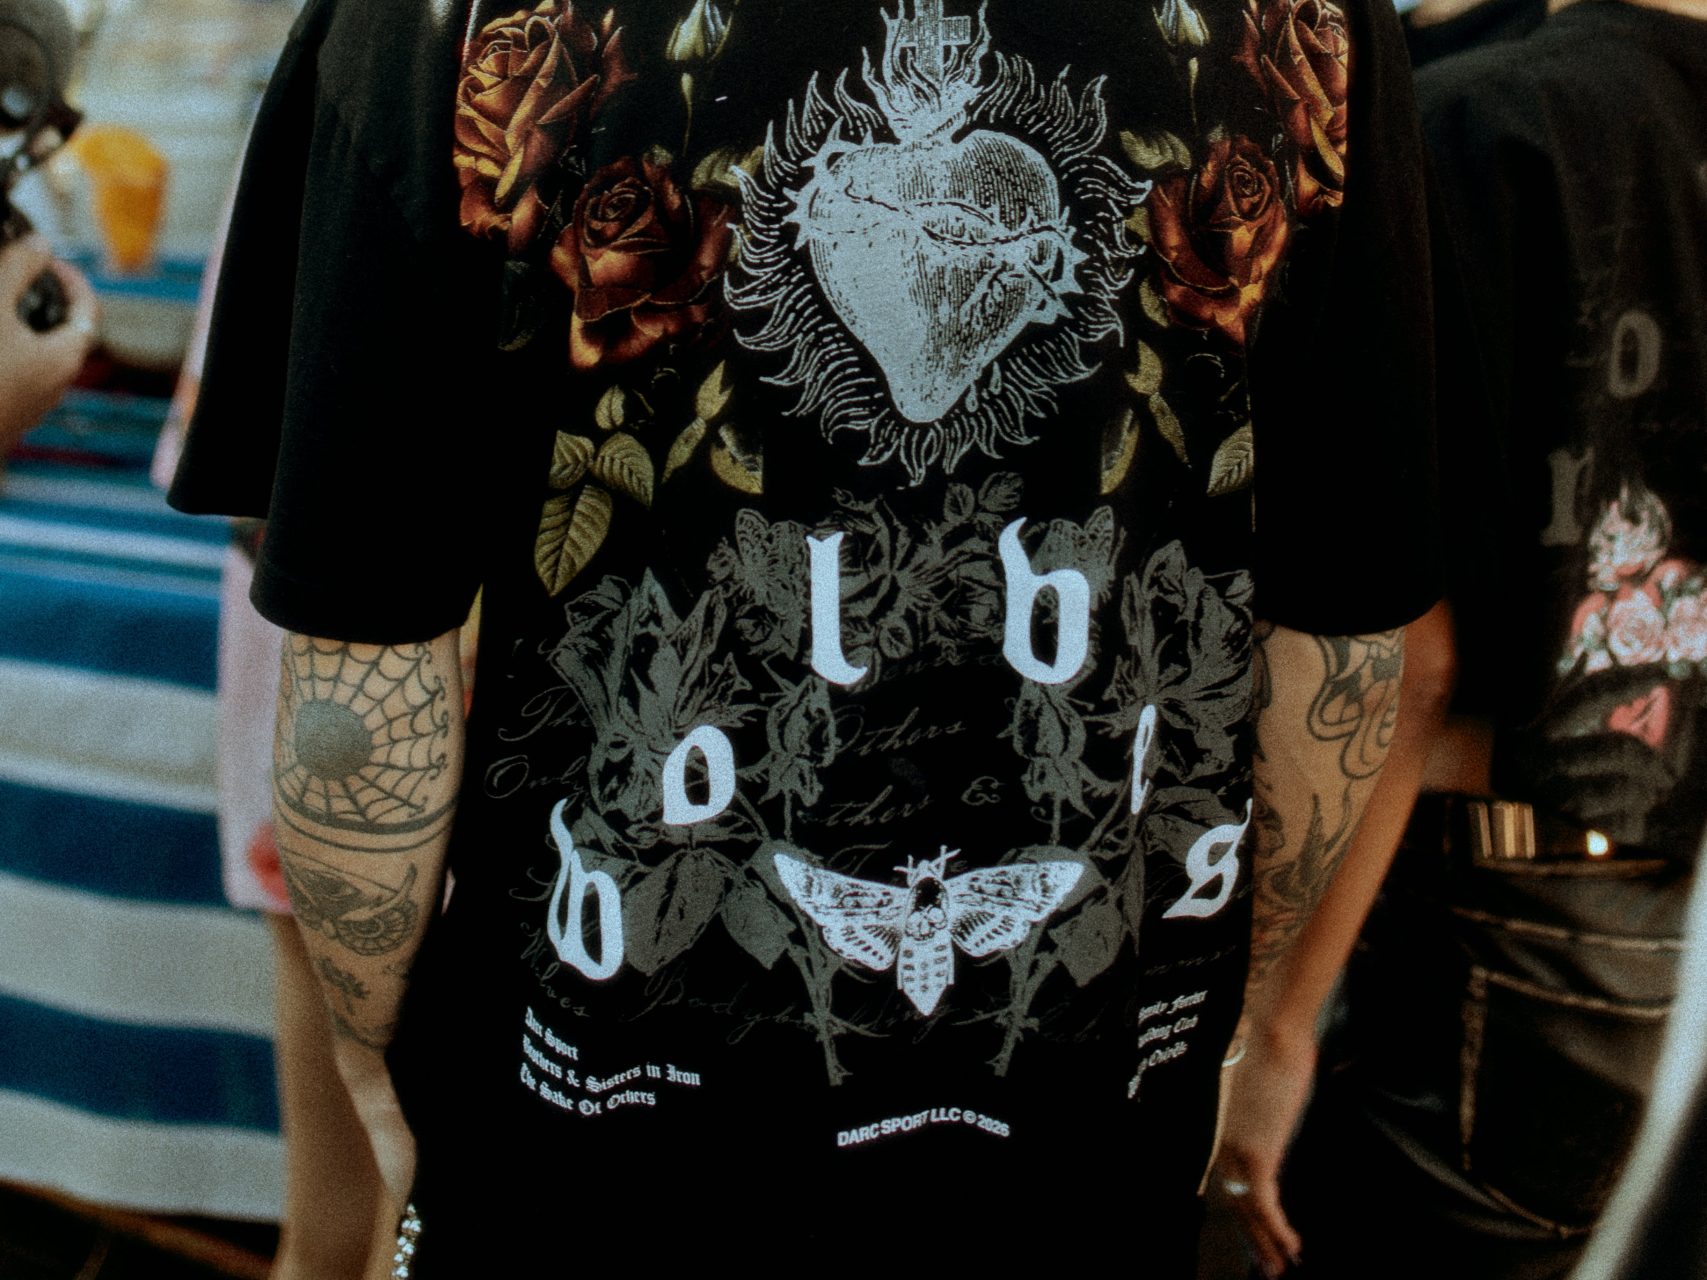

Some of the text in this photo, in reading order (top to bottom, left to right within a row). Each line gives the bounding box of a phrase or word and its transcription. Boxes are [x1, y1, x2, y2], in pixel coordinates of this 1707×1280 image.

[544, 1027, 579, 1061] Sport
[566, 1069, 580, 1088] &
[585, 1064, 642, 1094] Sisters
[645, 1062, 661, 1079] in
[666, 1063, 702, 1086] Iron
[539, 1080, 574, 1110] Sake
[578, 1098, 603, 1116] Of
[606, 1089, 657, 1111] Others
[837, 1123, 881, 1147] DARC
[880, 1109, 931, 1136] SPORT
[930, 1107, 963, 1123] LLC
